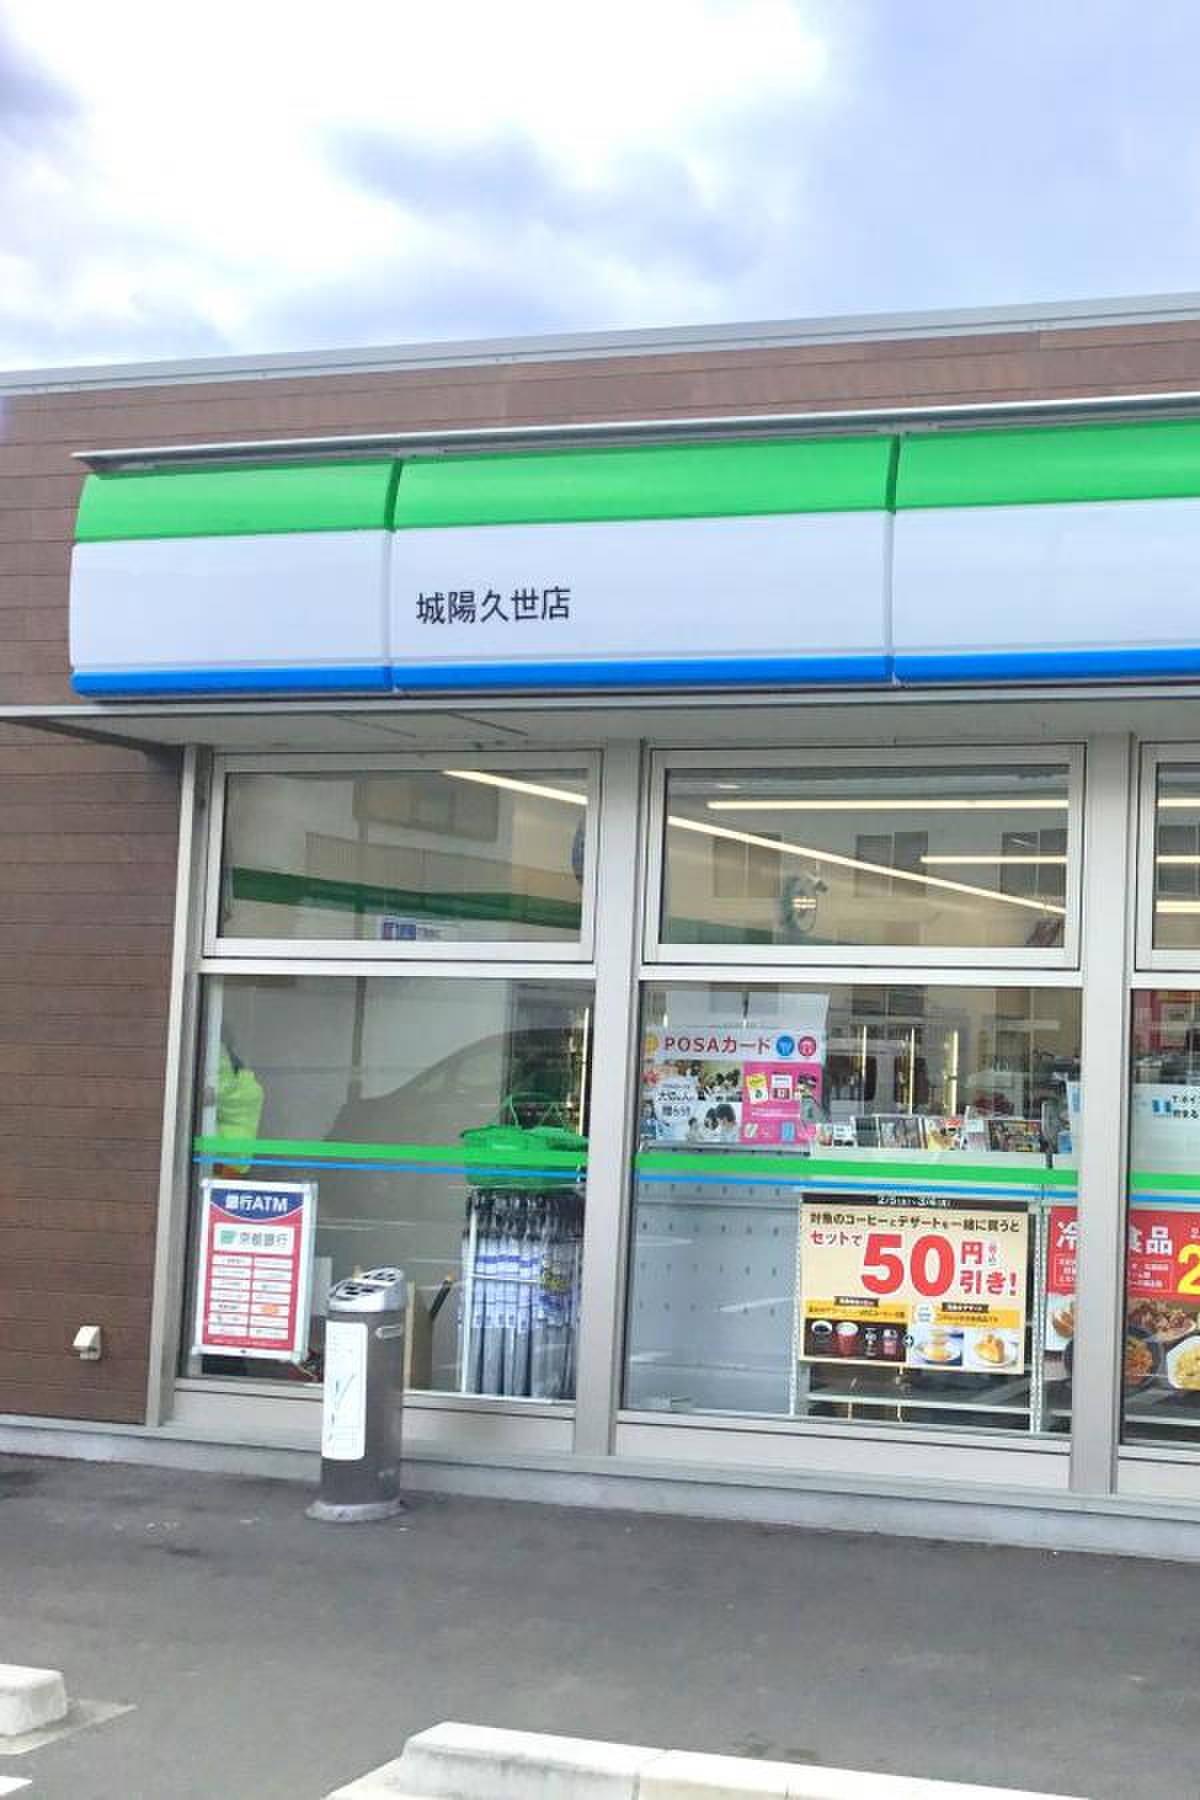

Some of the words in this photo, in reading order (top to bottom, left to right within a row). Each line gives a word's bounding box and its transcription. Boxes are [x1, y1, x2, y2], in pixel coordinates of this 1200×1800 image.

[415, 586, 571, 624] 城陽久世店
[664, 1035, 771, 1054] POSAカード
[861, 1233, 956, 1297] 50
